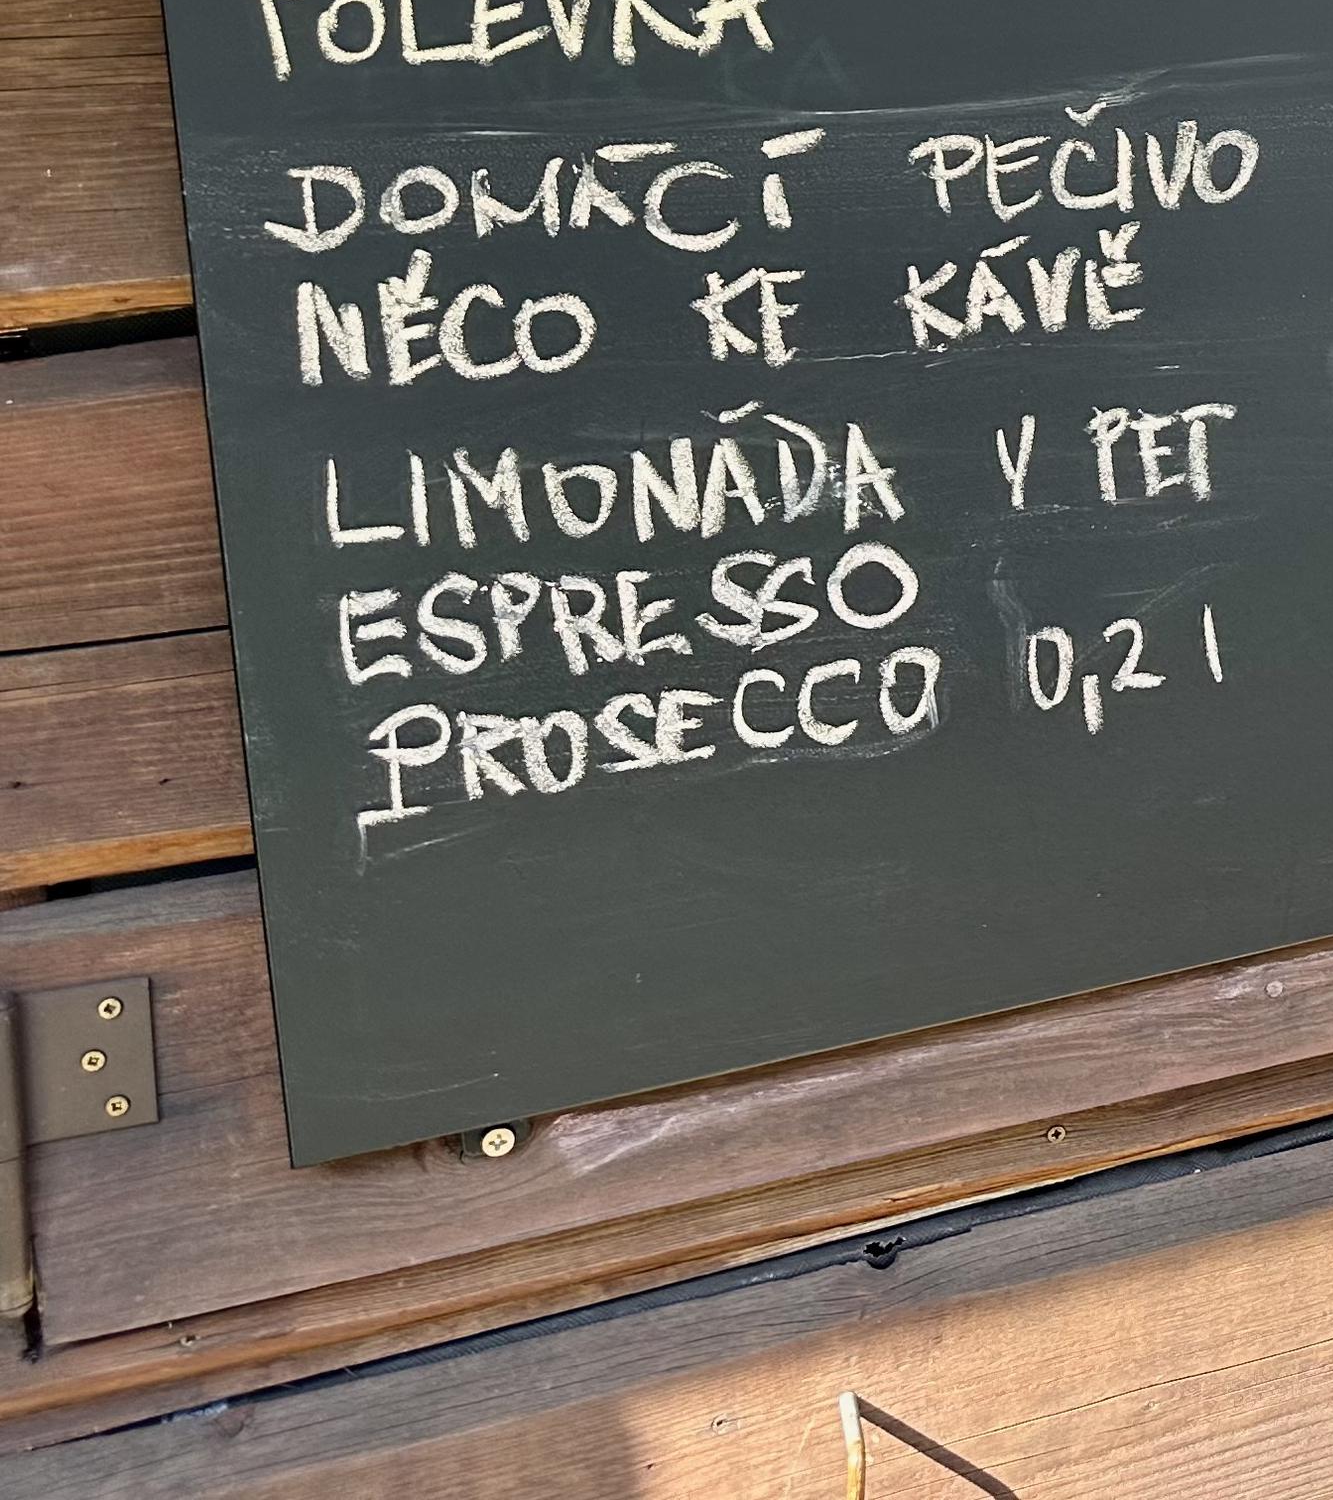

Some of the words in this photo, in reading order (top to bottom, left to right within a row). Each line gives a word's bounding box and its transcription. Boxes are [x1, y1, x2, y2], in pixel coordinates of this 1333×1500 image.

[256, 126, 828, 252] DOMÁCÍ
[294, 248, 599, 387] NĚCO
[688, 266, 807, 369] KE
[900, 219, 1146, 352] KÁVĚ
[325, 399, 907, 550] LIMONÁDA
[1085, 401, 1239, 507] PET
[337, 541, 921, 687] ESPRESSO
[357, 645, 942, 828] PROSECCO
